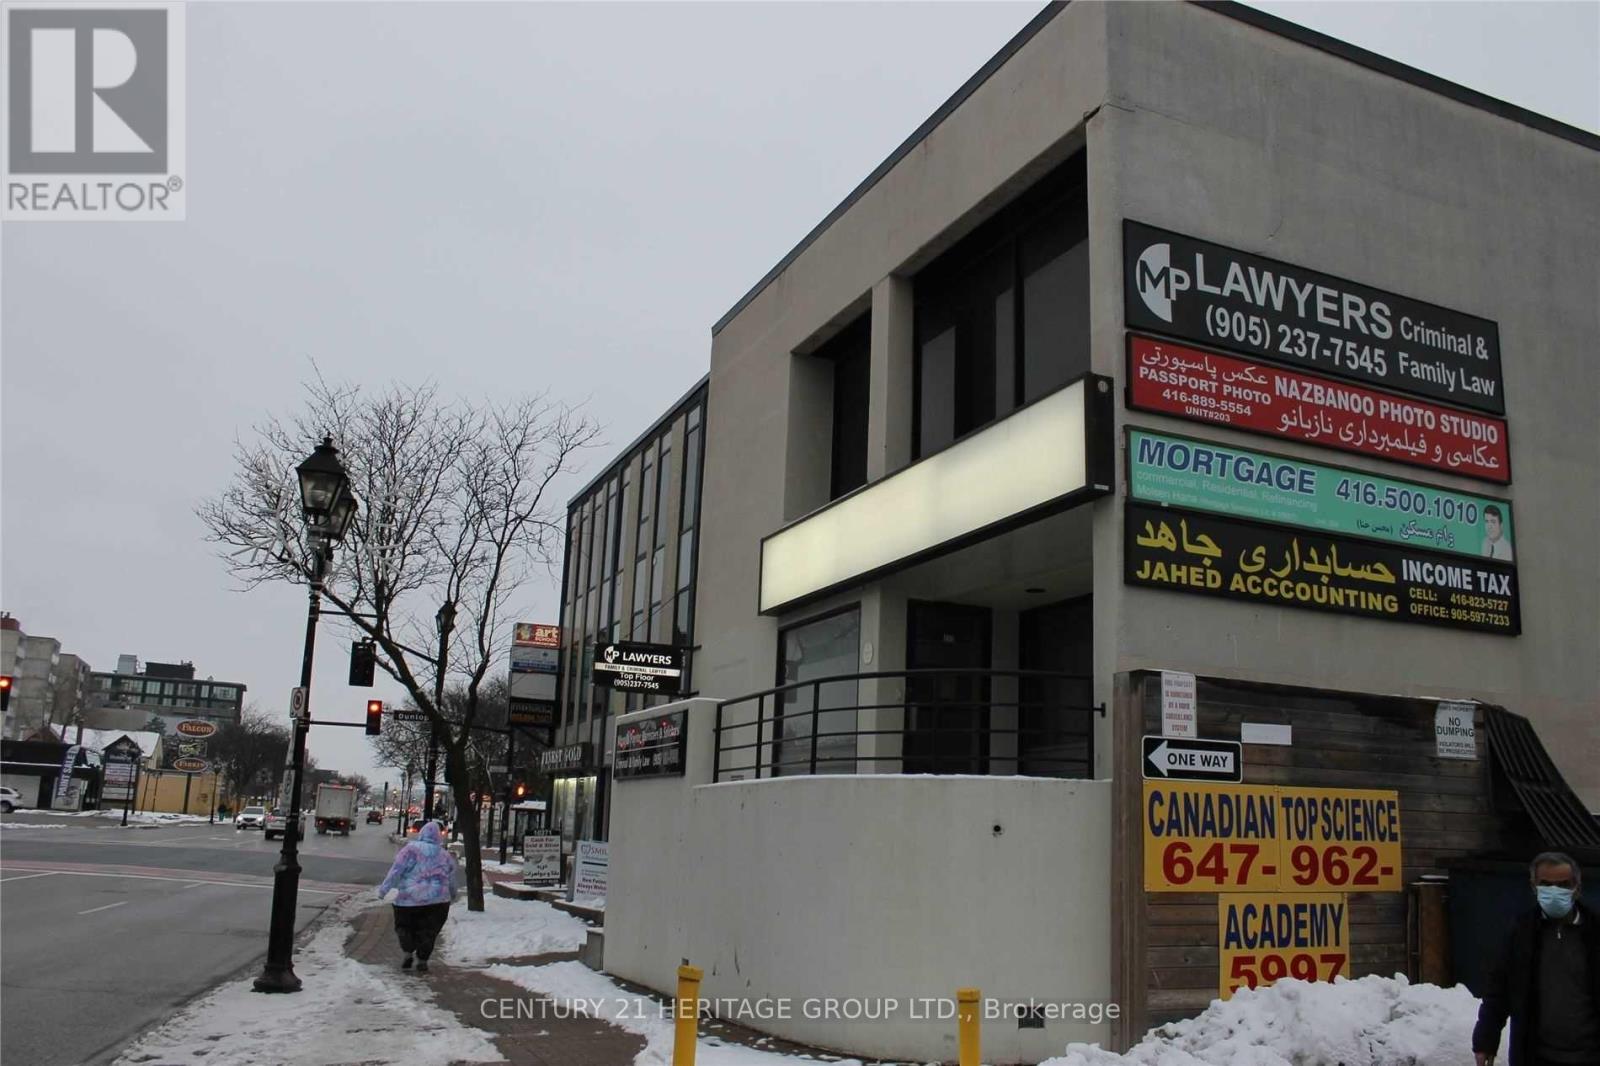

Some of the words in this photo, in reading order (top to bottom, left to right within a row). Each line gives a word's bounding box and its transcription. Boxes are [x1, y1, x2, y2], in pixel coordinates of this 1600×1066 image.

[1196, 253, 1393, 339] LAWYERS
[1206, 304, 1270, 349] (905)
[1278, 324, 1387, 377] 237-7545
[1400, 316, 1472, 356] Criminal
[1475, 337, 1489, 359] &
[1139, 367, 1218, 393] PASSPORT
[1223, 384, 1271, 405] PHOTO
[1399, 352, 1456, 393] Family
[1460, 367, 1495, 397] Law
[1162, 388, 1252, 416] 416-889-5554
[1185, 406, 1231, 422] UNIT#203
[1275, 375, 1375, 416] NAZBANOO
[1379, 400, 1435, 430] PHOTO
[1440, 415, 1498, 444] STUDIO
[1137, 437, 1317, 496] MORTGAGE
[1335, 478, 1479, 525] 416.500.1010
[1136, 560, 1222, 589] JAHED
[1229, 573, 1399, 613] ACCCOUNTING
[1402, 558, 1473, 591] INCOME
[1477, 571, 1512, 596] TAX
[1409, 587, 1437, 601] CELL:
[1410, 603, 1449, 618] OFFICE:
[620, 672, 633, 680] Top
[622, 652, 672, 665] LAWYERS
[1436, 726, 1475, 737] DUMPING
[1449, 717, 1461, 727] NO
[1167, 752, 1196, 767] ONE
[1200, 754, 1228, 768] WAY
[1149, 790, 1275, 840] CANADIAN
[1162, 841, 1276, 886] 647-
[1291, 845, 1394, 886] 962-
[1224, 903, 1345, 949] ACADEMY
[1230, 953, 1346, 993] 5997
